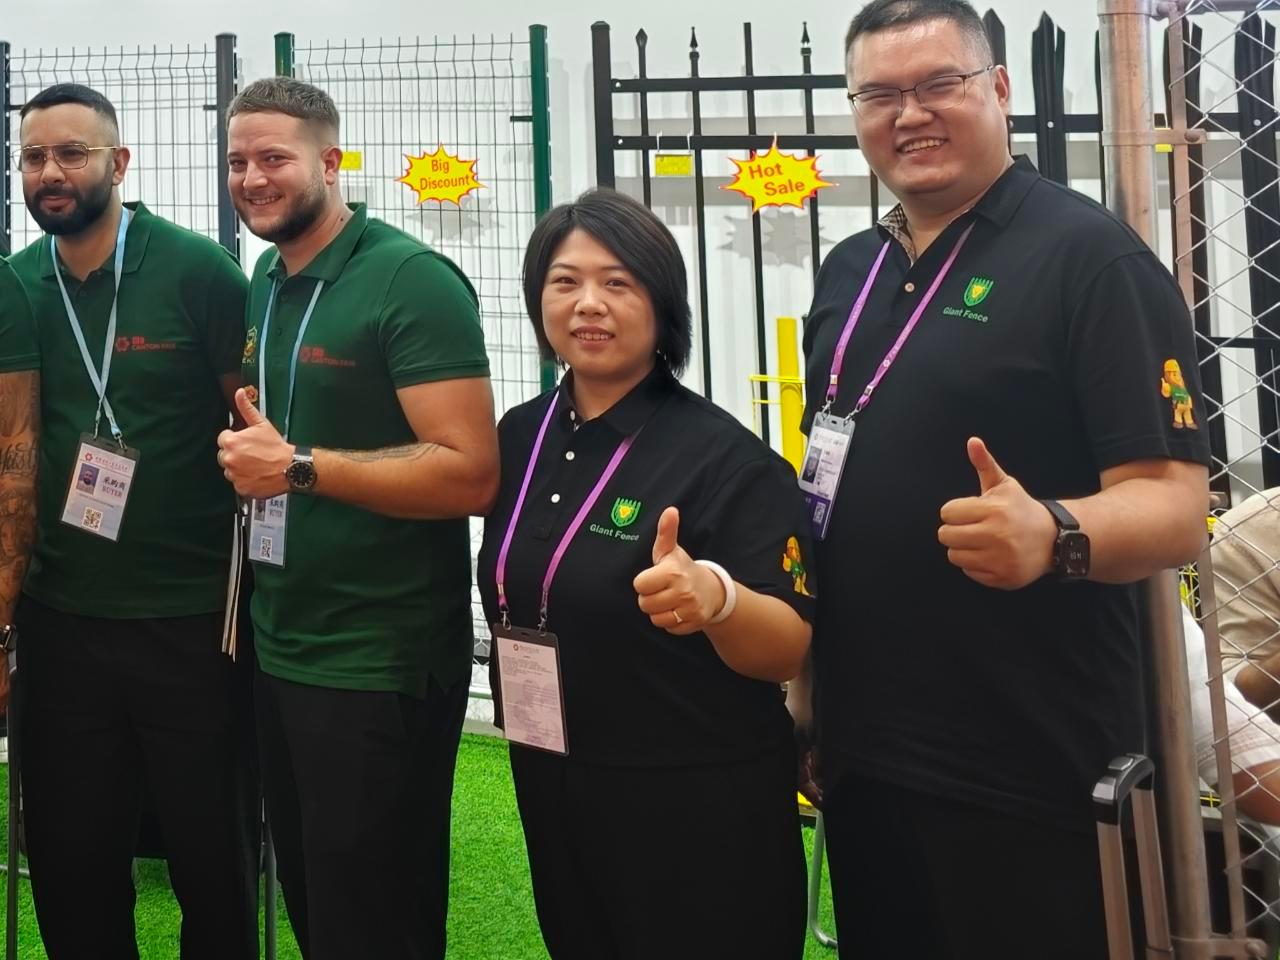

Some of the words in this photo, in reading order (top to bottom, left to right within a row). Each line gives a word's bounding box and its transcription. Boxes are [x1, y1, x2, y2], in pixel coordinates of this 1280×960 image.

[431, 159, 450, 174] Big
[748, 162, 784, 180] Hot
[419, 174, 470, 191] Discount
[764, 179, 806, 197] Sale
[943, 306, 963, 317] Giant
[963, 309, 988, 323] Fence
[102, 484, 123, 498] BUYER
[589, 523, 614, 537] Giant
[614, 530, 640, 541] Fence
